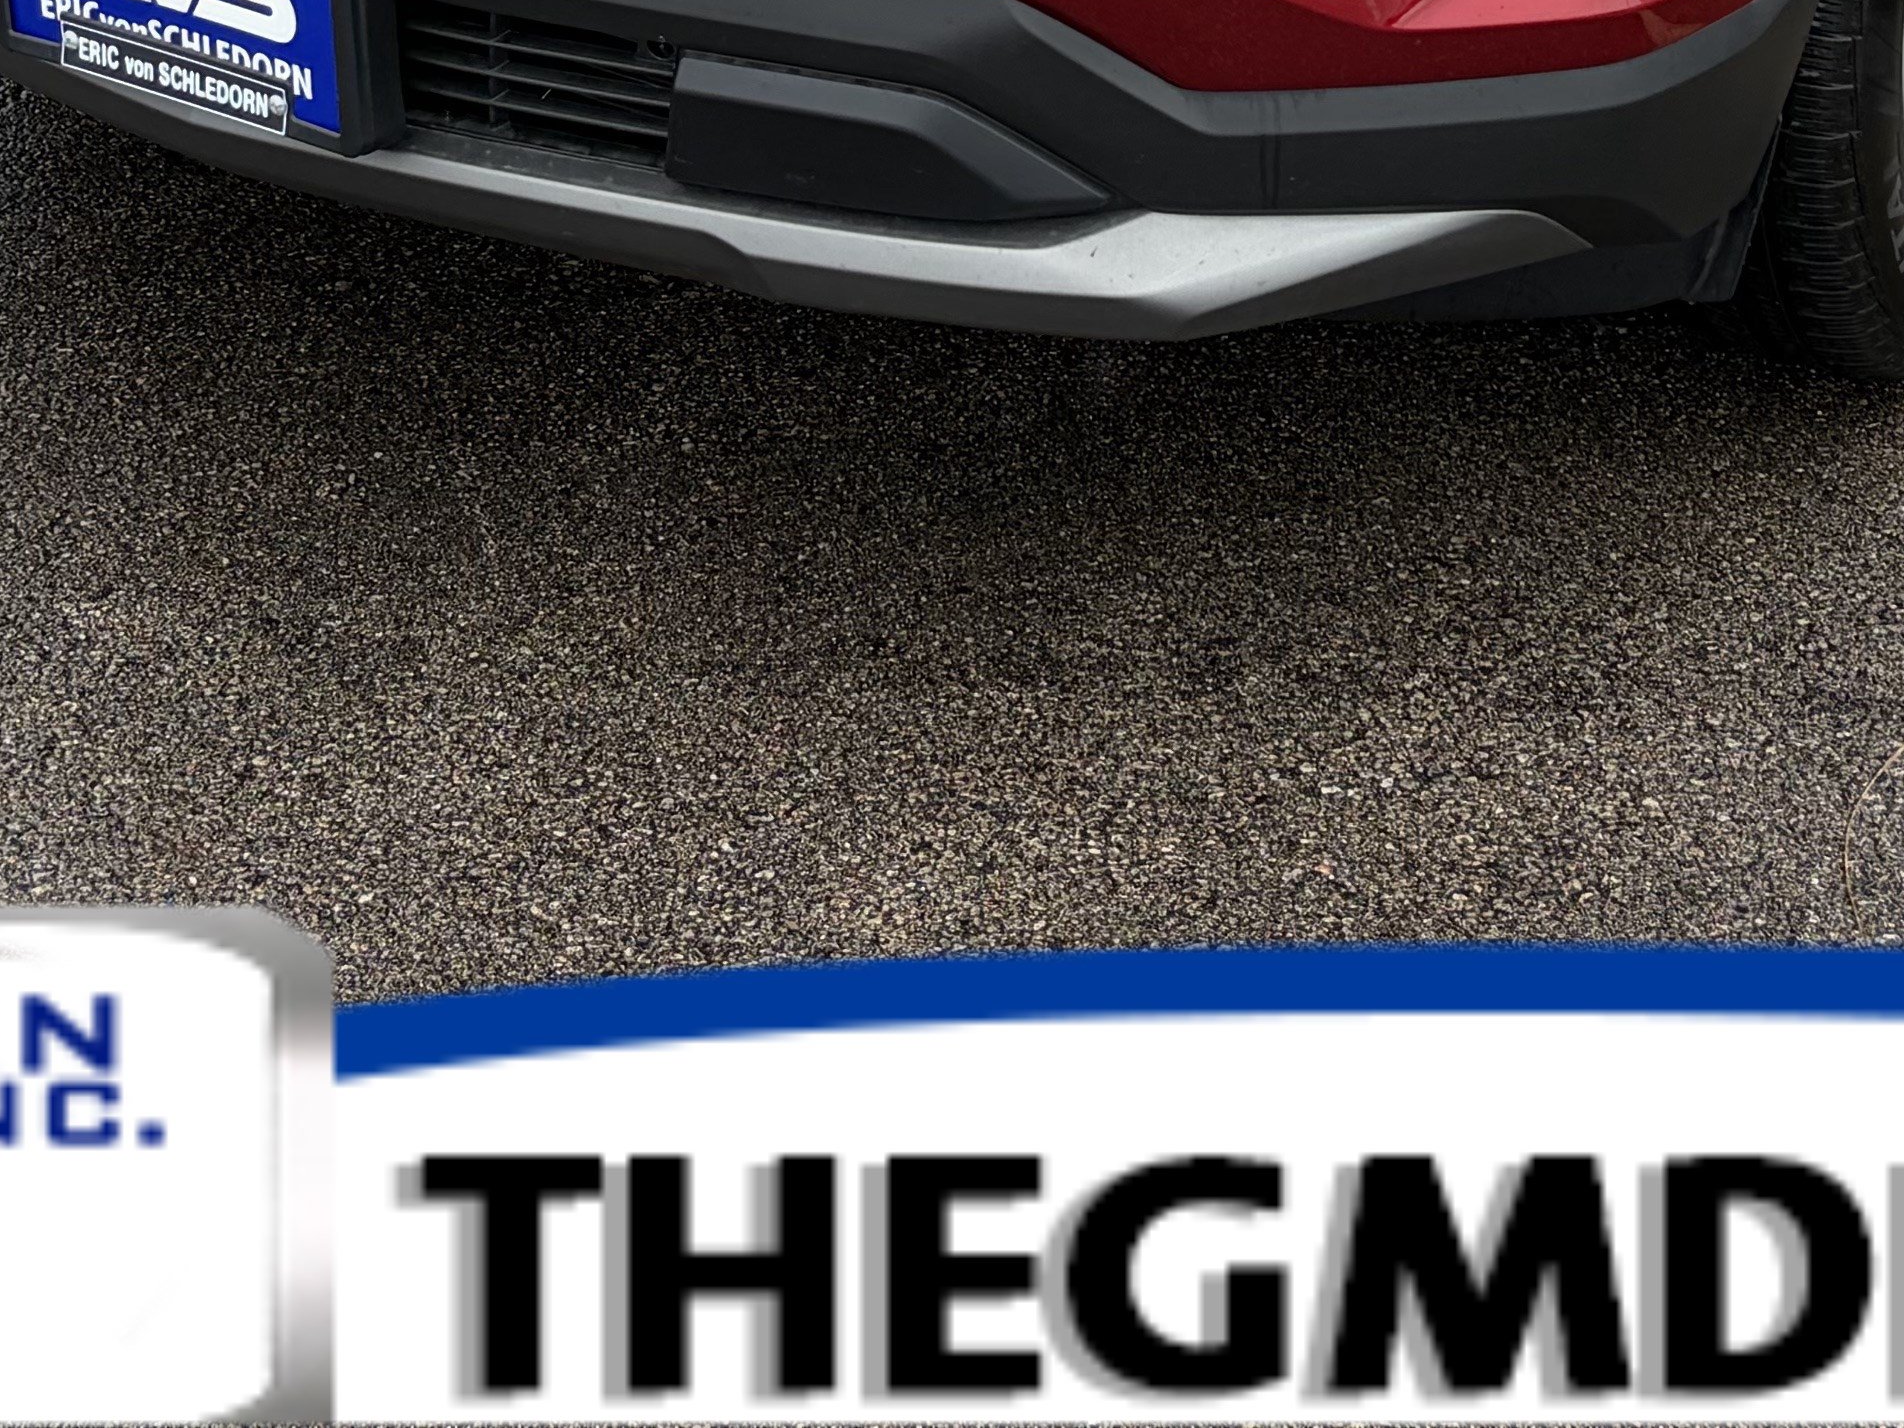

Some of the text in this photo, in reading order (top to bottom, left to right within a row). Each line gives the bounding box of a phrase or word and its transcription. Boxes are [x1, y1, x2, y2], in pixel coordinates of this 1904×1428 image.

[79, 36, 269, 119] ERIC von SCHLEDORN
